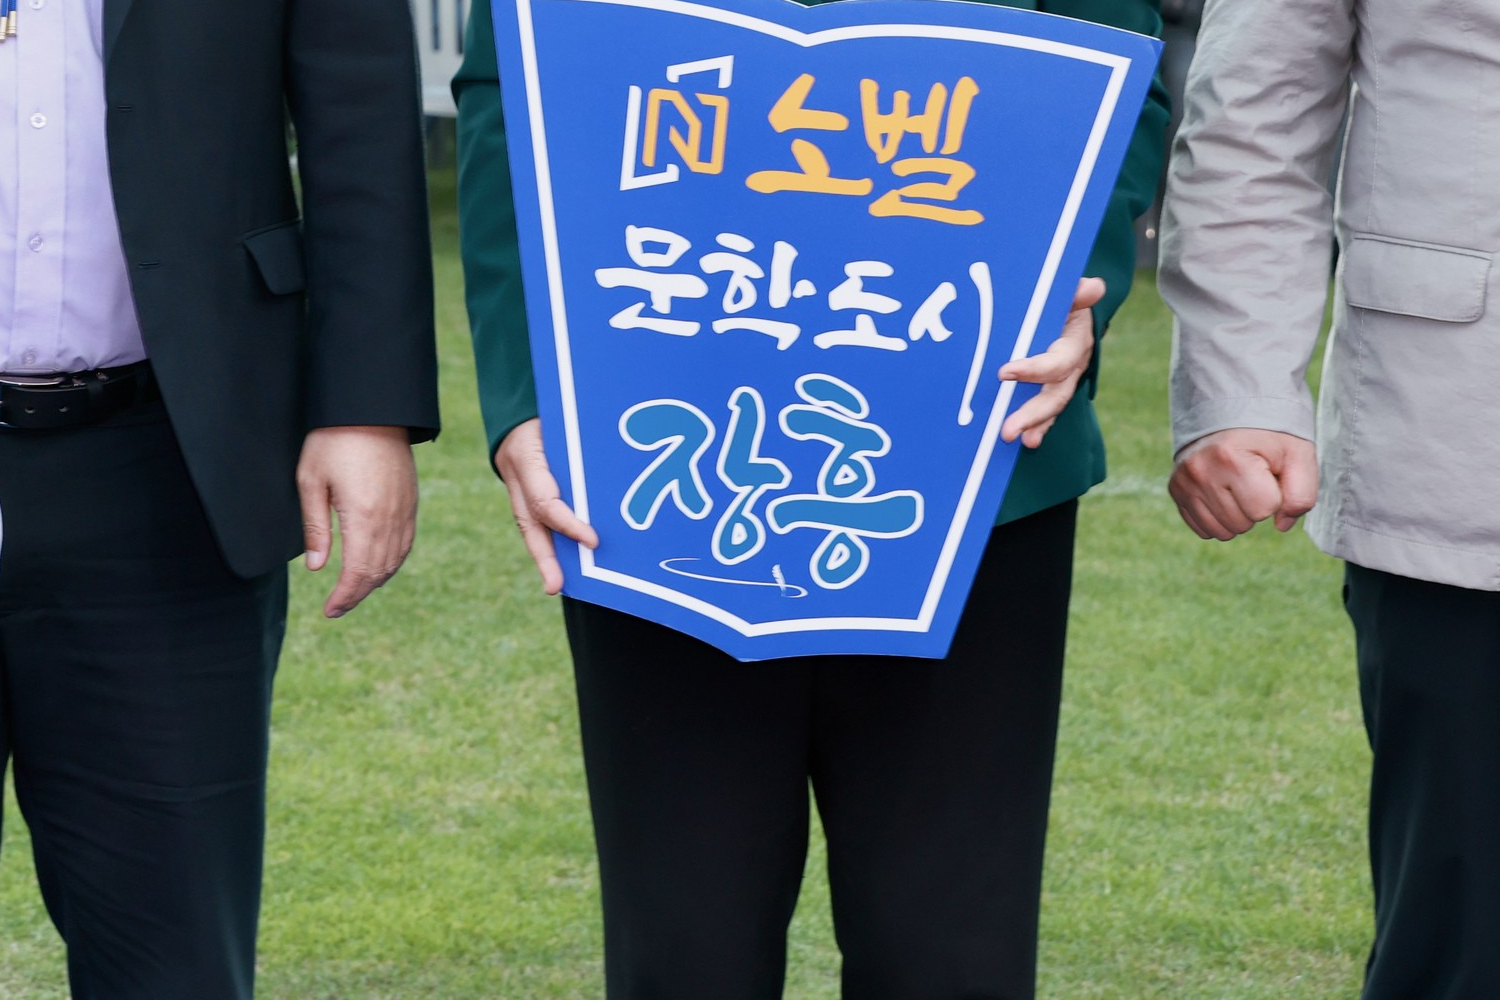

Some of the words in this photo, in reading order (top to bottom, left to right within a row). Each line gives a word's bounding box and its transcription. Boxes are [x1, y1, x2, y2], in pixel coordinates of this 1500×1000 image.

[745, 73, 984, 226] 노벨
[595, 224, 994, 426] 문학도시
[618, 373, 925, 590] 장흥
